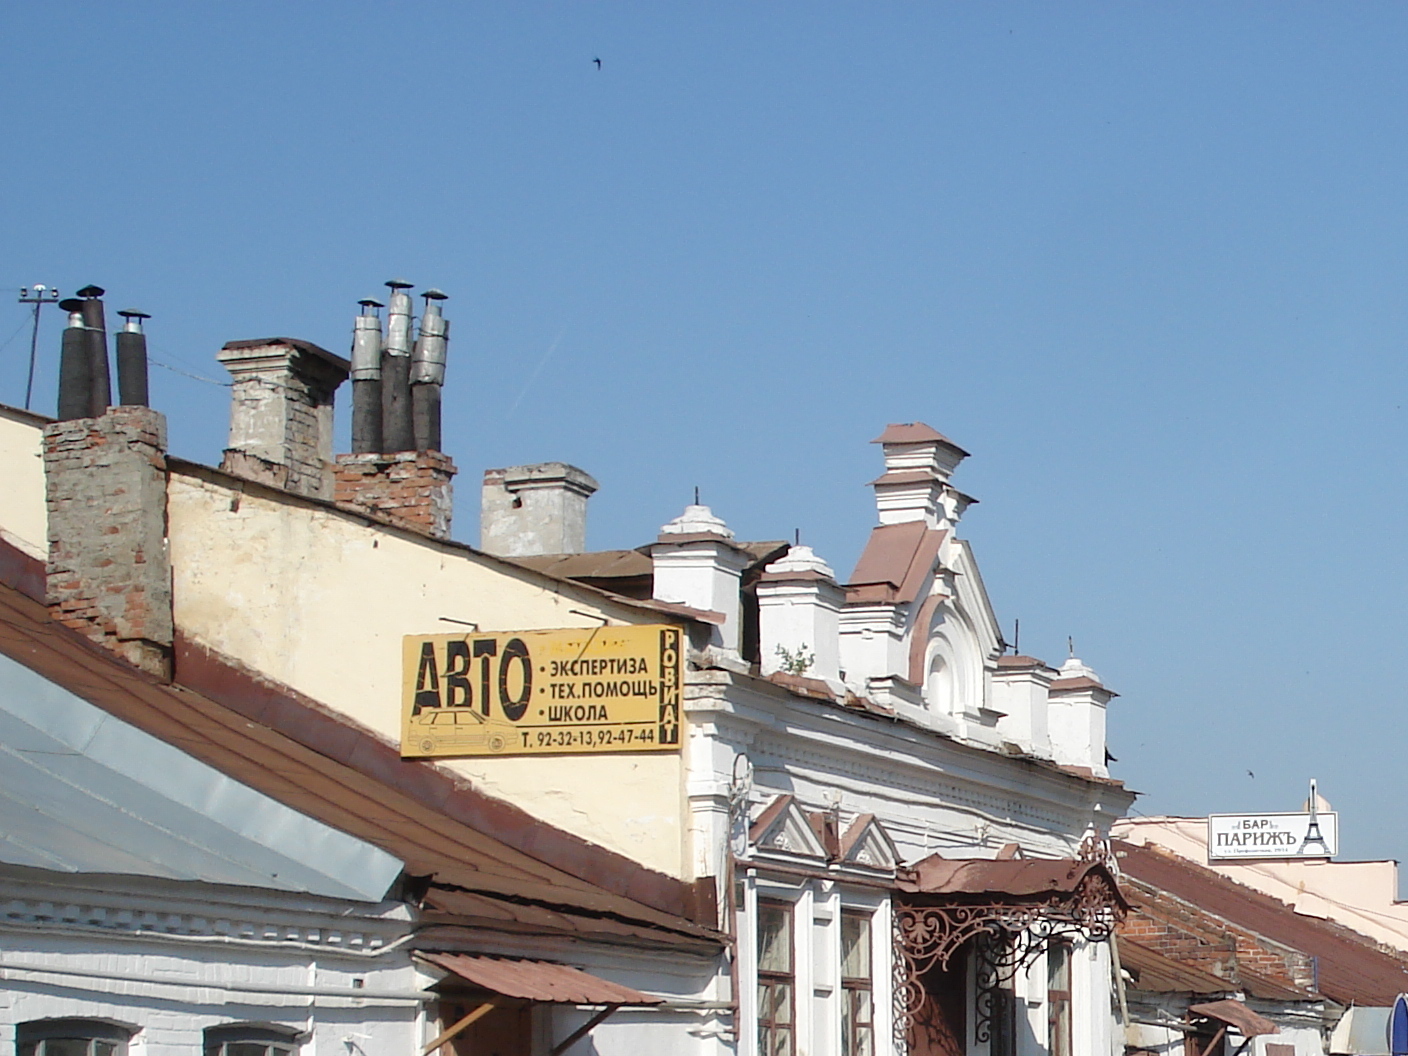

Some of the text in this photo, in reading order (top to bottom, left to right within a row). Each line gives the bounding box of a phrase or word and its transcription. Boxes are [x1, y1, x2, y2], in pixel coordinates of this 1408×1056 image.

[550, 658, 648, 677] ЭКСПЕРТИЗА
[412, 638, 532, 721] АВТО
[663, 630, 677, 742] РОВИАТ
[550, 680, 658, 699] ТЕХ.ПОМОЩЬ
[548, 705, 609, 722] ШКОЛА
[521, 732, 533, 748] Т.
[1242, 820, 1269, 829] БАР
[1216, 831, 1297, 847] ПАРИЖЪ
